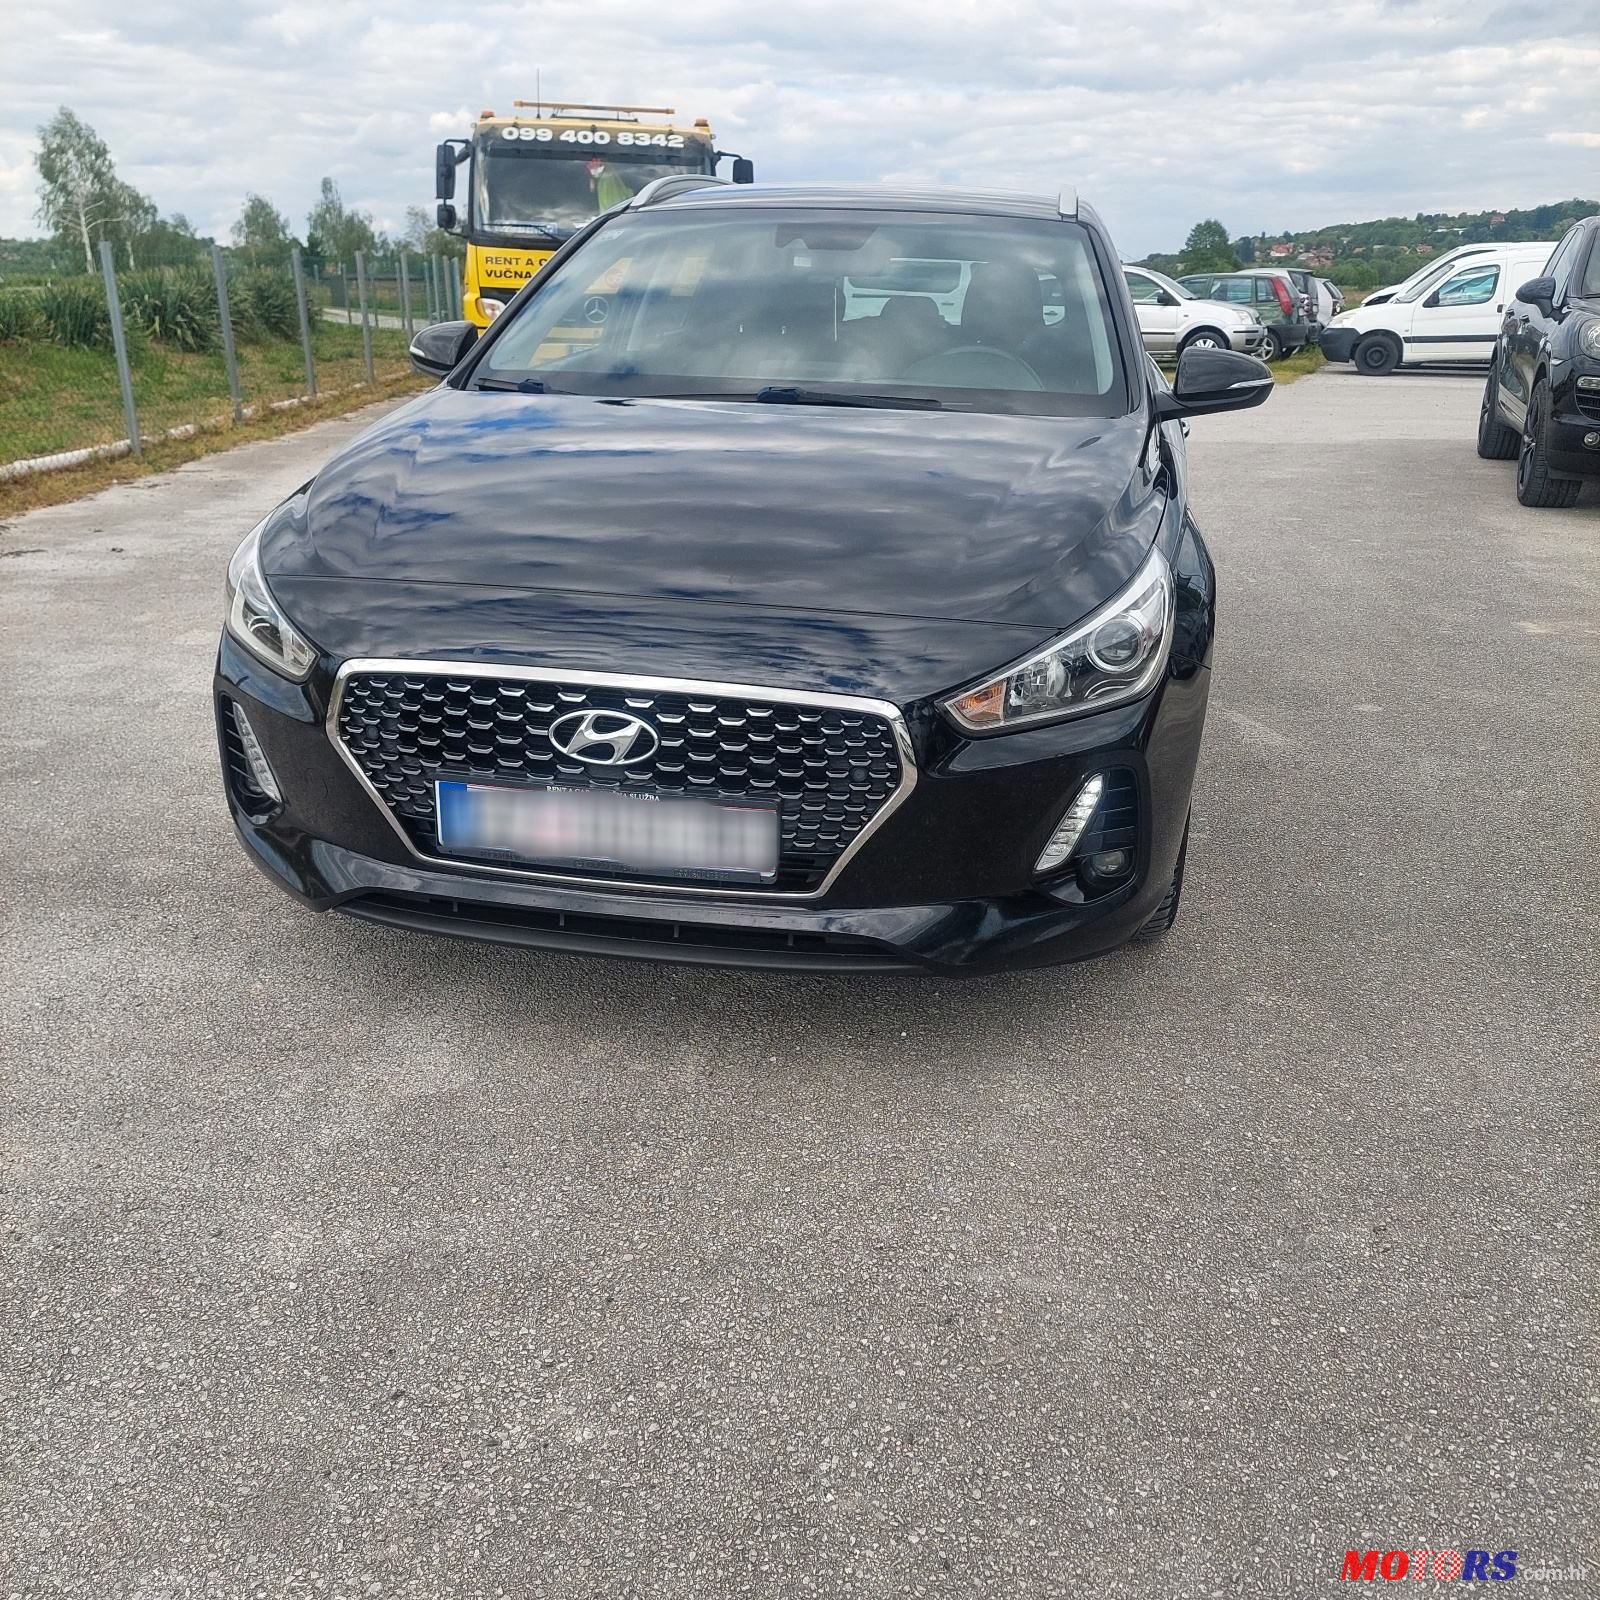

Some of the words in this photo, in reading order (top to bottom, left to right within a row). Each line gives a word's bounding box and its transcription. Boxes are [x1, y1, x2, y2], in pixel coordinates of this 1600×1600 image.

[501, 126, 553, 142] 099
[559, 129, 611, 145] 400
[617, 132, 685, 148] 8342
[485, 256, 521, 265] RENT
[525, 258, 535, 266] A
[485, 267, 533, 279] VUČNA
